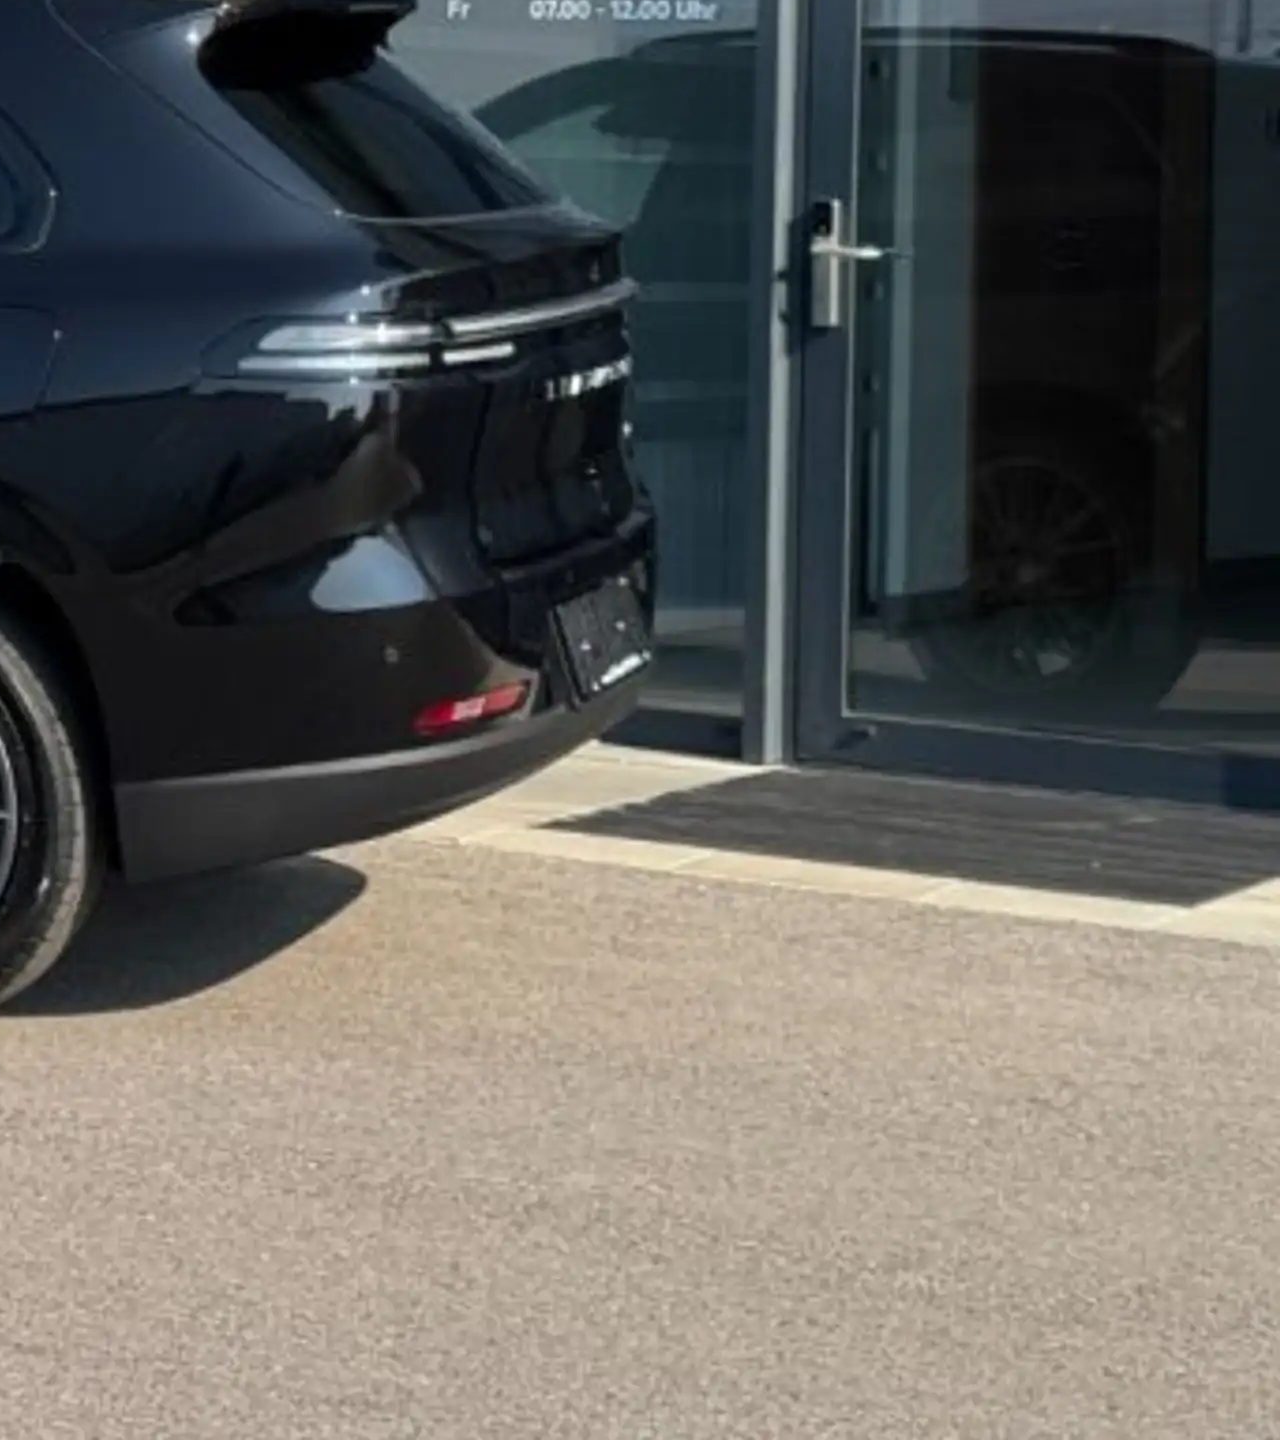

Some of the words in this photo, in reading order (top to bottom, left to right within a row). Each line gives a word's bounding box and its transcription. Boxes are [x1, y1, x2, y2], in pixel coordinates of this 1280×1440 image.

[529, 0, 591, 20] 07.00
[610, 0, 671, 20] 12.00
[676, 0, 717, 20] Uhr
